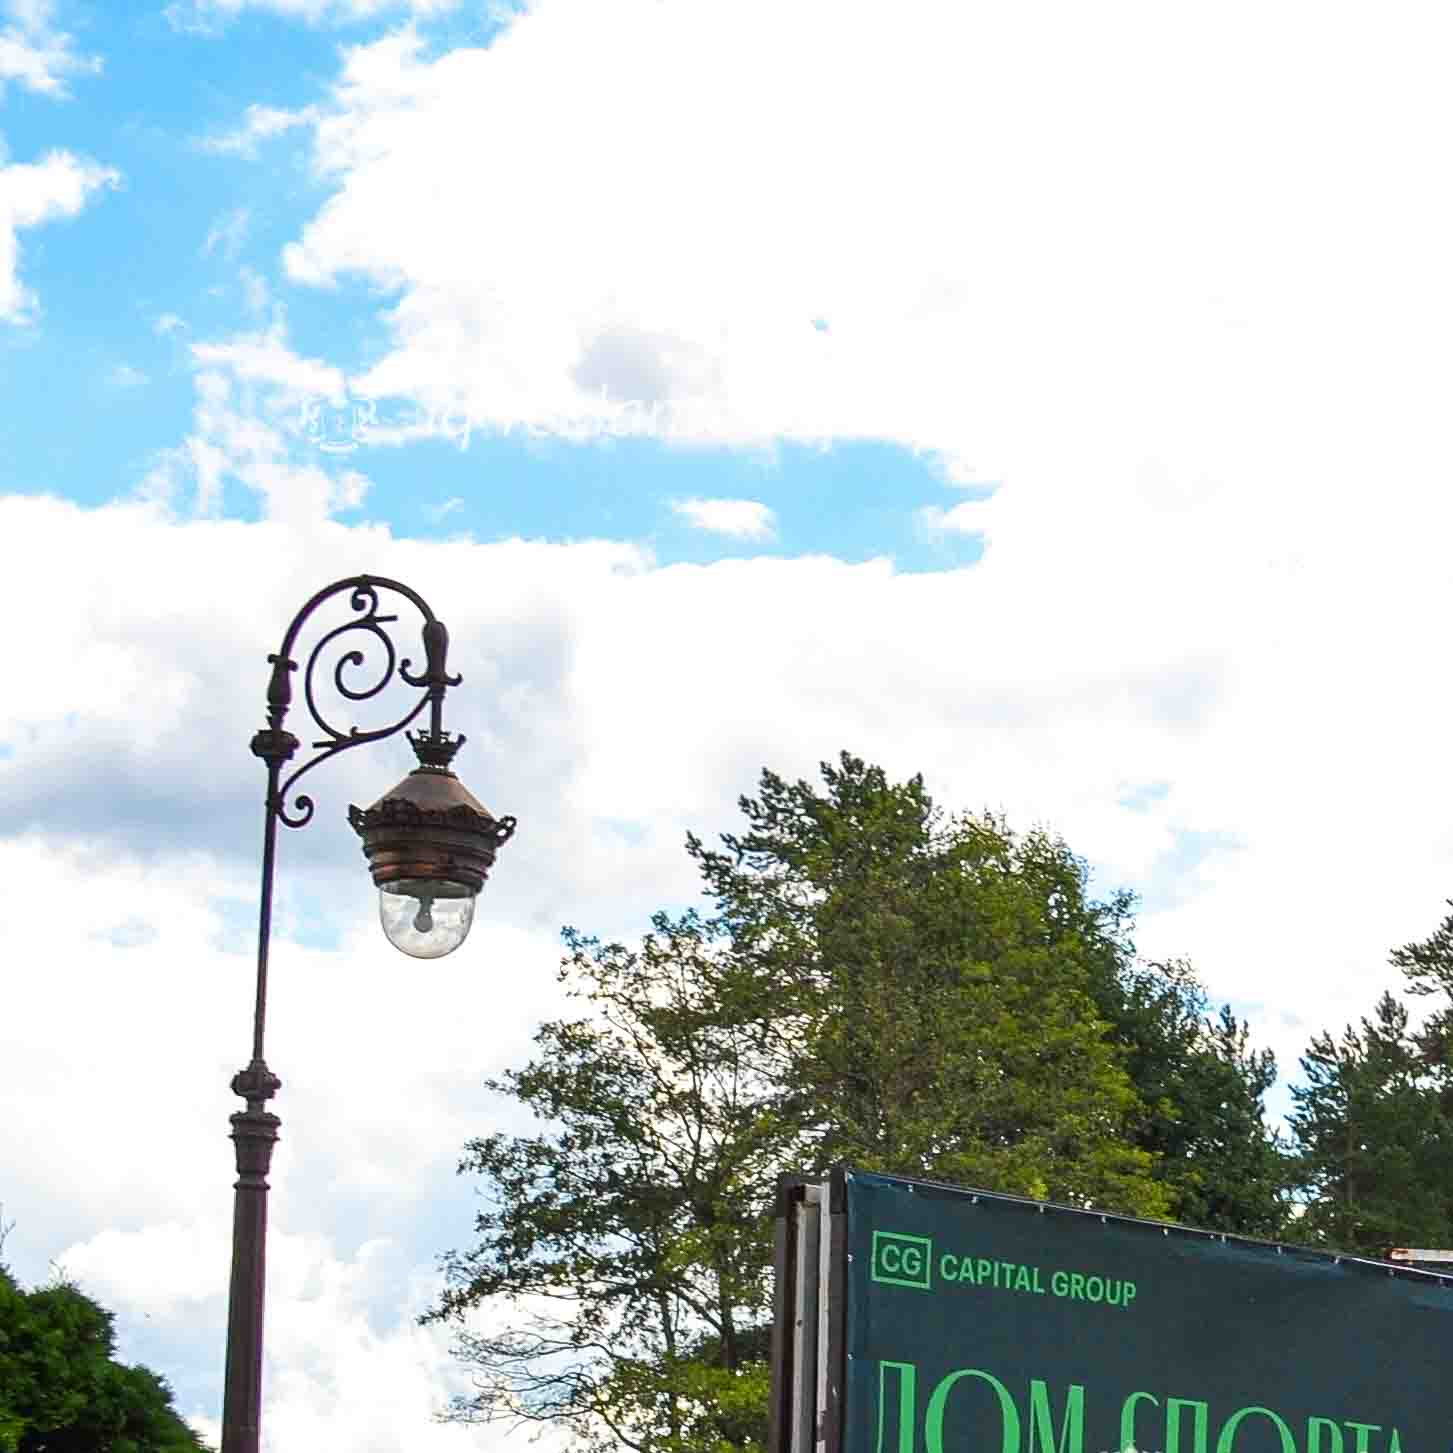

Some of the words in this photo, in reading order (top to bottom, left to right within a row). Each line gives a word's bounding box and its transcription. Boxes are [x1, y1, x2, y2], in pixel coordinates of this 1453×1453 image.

[880, 1243, 922, 1277] CG
[939, 1253, 1046, 1294] CAPITAL
[1050, 1270, 1137, 1307] GROUP
